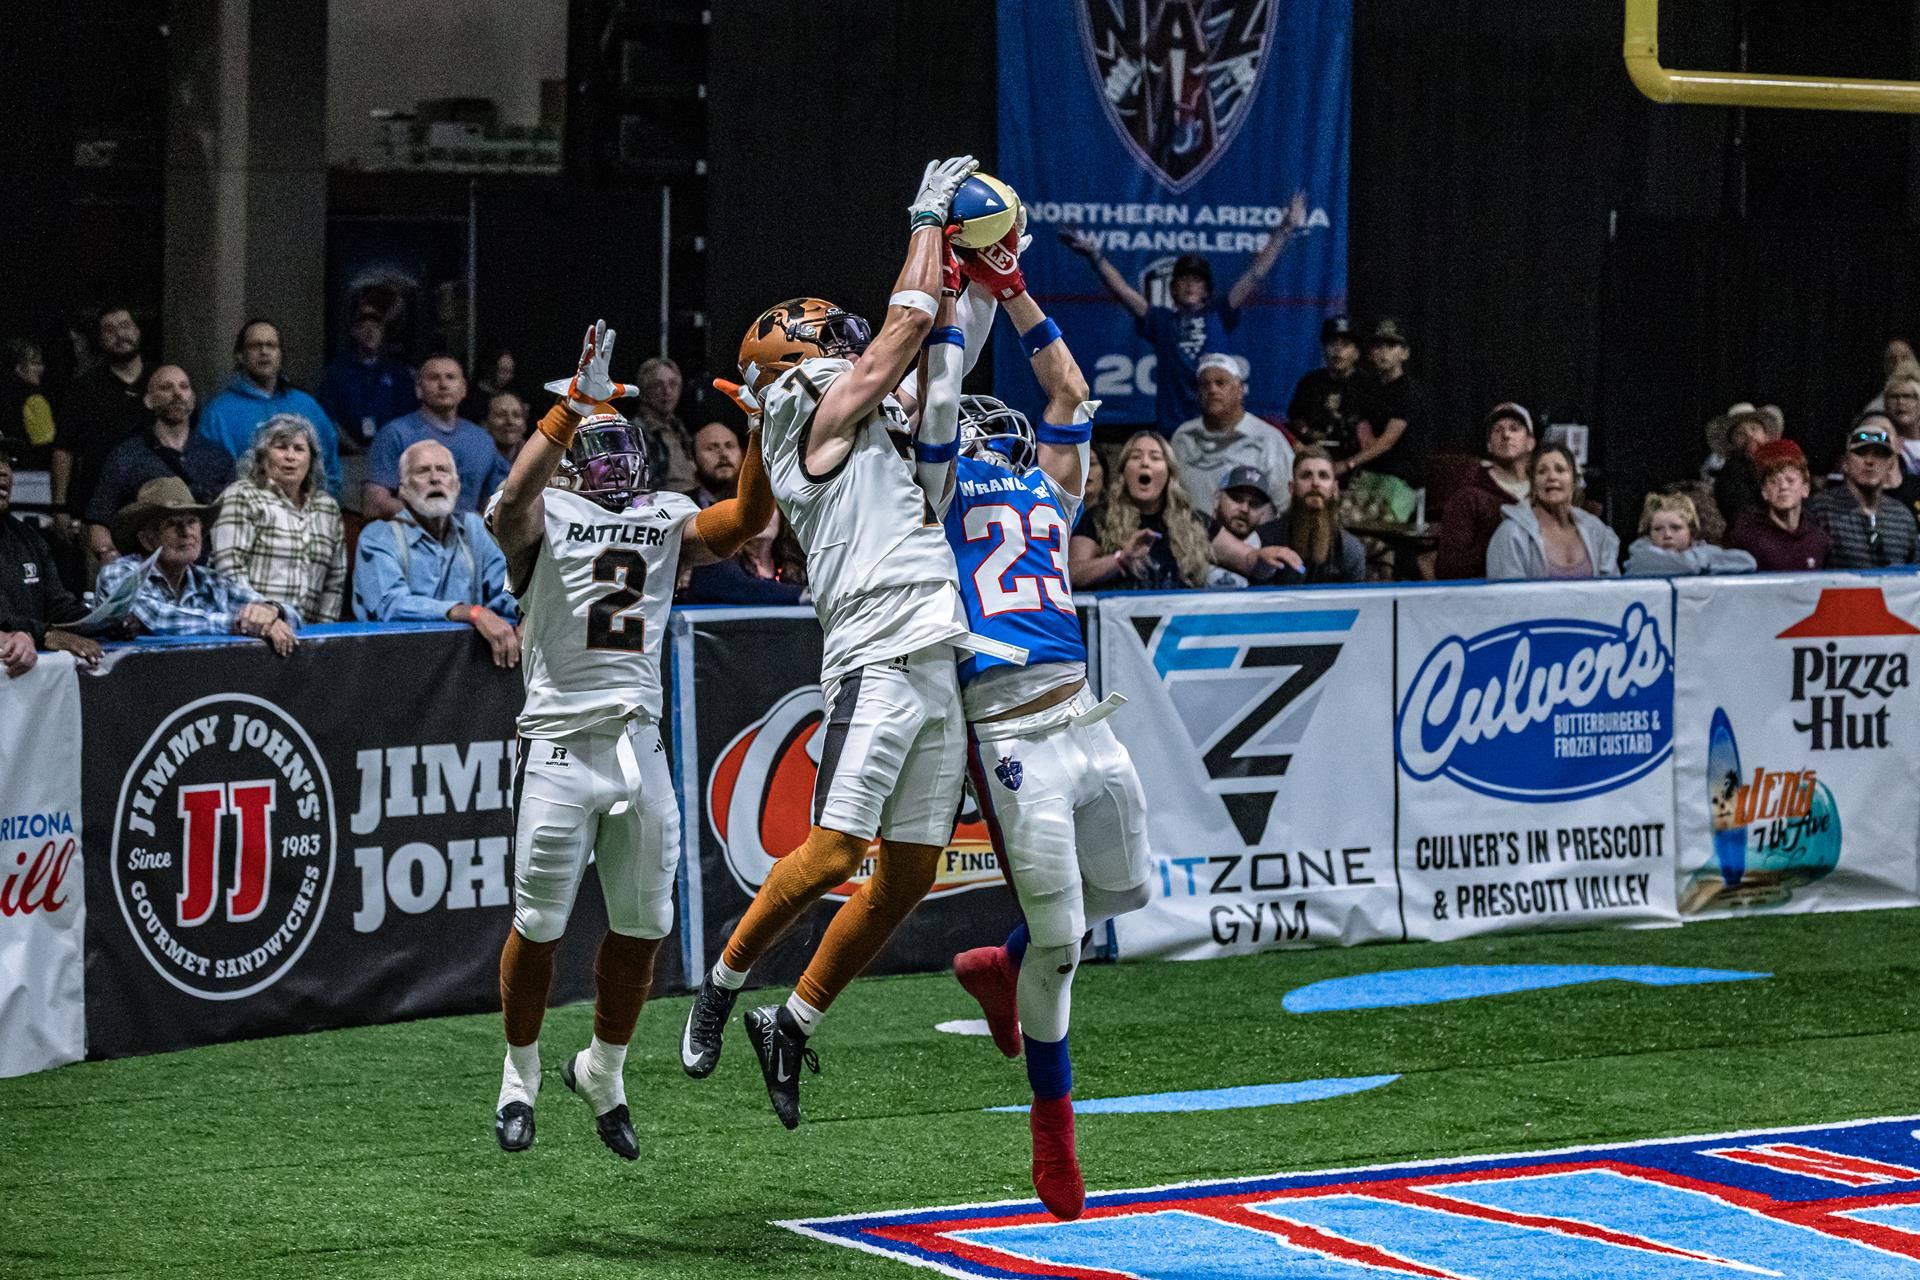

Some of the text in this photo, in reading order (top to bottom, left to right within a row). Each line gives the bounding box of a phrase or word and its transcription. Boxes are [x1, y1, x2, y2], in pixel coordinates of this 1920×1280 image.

[1028, 203, 1330, 228] NORTHERN ARIZOA
[565, 522, 668, 547] RATTLERS
[963, 503, 1077, 619] 23
[586, 548, 647, 653] 2
[1400, 606, 1667, 777] Culver's
[1790, 641, 1911, 702] Pizza
[1553, 710, 1662, 735] BUTTERBURGERS &
[1553, 733, 1653, 758] FROZEN CUSTARD
[1793, 695, 1893, 751] Hut
[129, 714, 320, 838] JIMMY JOHN'S
[350, 740, 517, 835] JIM
[128, 834, 321, 870] Since 1983
[176, 779, 276, 927] JJ
[946, 851, 1000, 872] FING
[1151, 848, 1376, 898] ITZONE
[1416, 823, 1665, 870] CULVER'S IN PRESCOTT
[353, 837, 515, 933] JOH
[1433, 873, 1650, 920] & PRESCOTT VALLEY
[131, 866, 320, 978] GOURMET SANDWICHES
[1210, 900, 1310, 946] GYM
